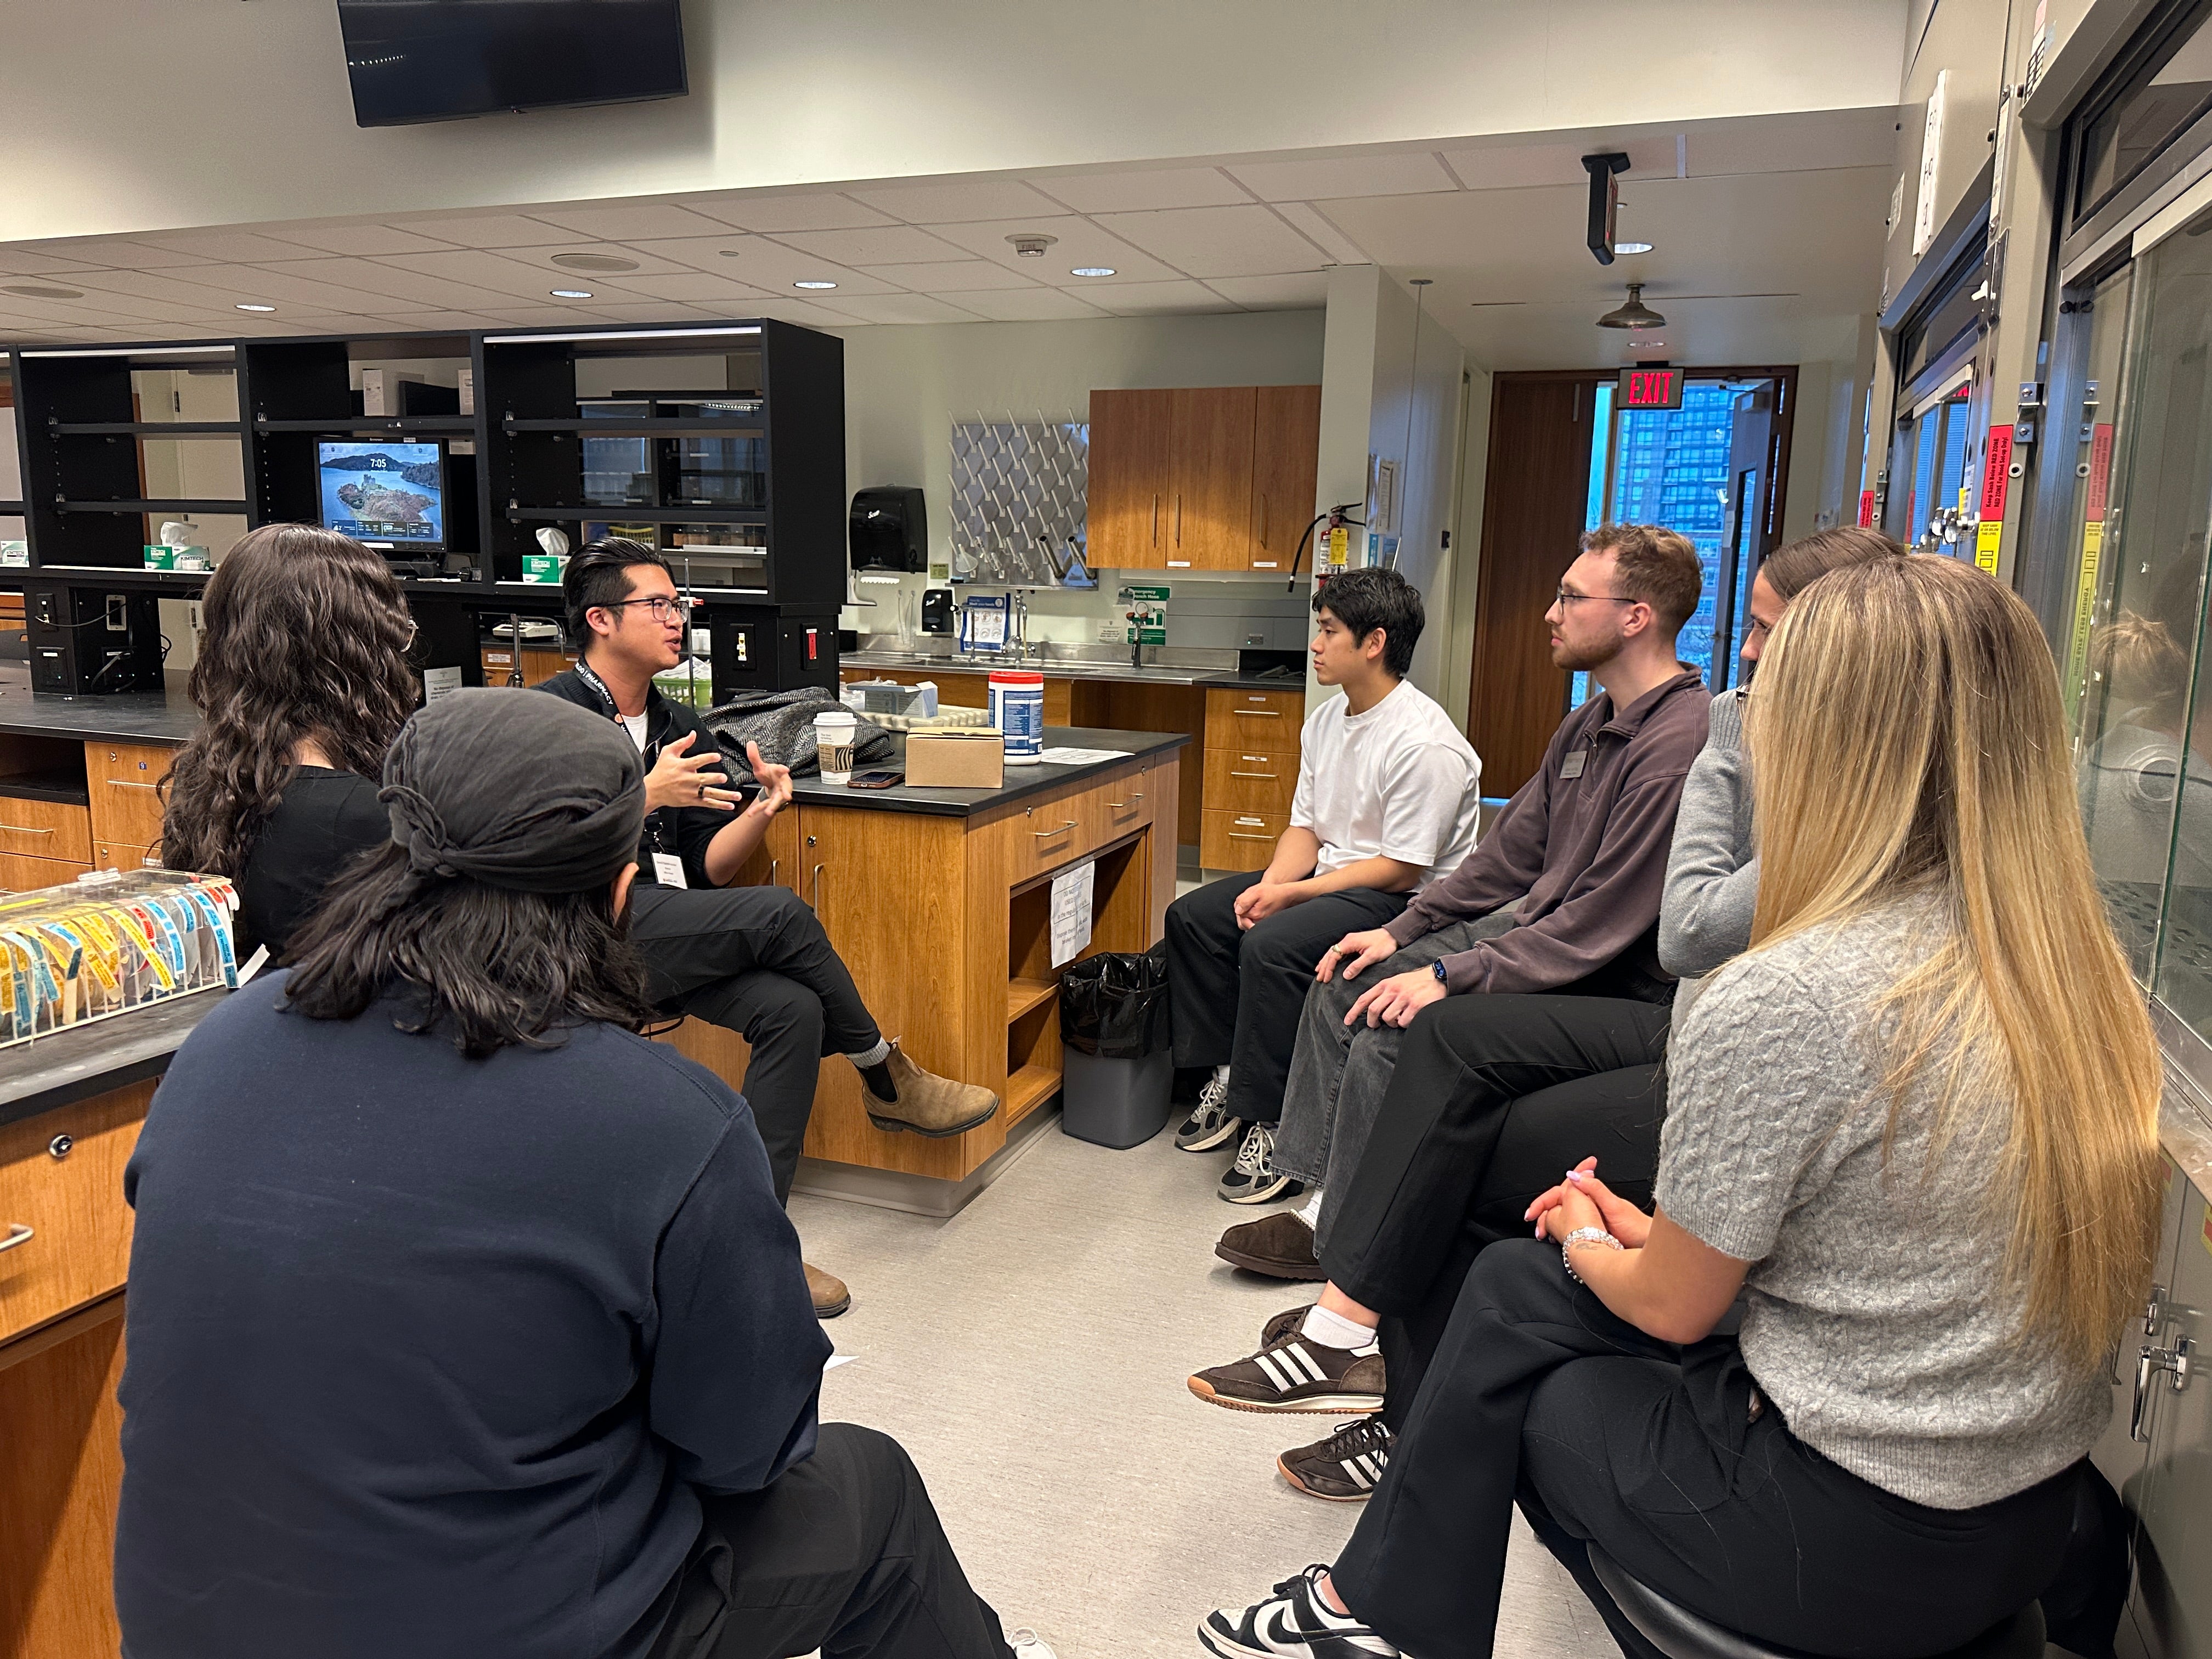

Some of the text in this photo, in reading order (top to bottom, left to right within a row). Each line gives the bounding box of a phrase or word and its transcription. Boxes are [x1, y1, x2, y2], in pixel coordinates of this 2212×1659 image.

[1629, 373, 1674, 404] EXIT
[370, 459, 386, 468] 7:05
[585, 673, 613, 704] PHARMACY
